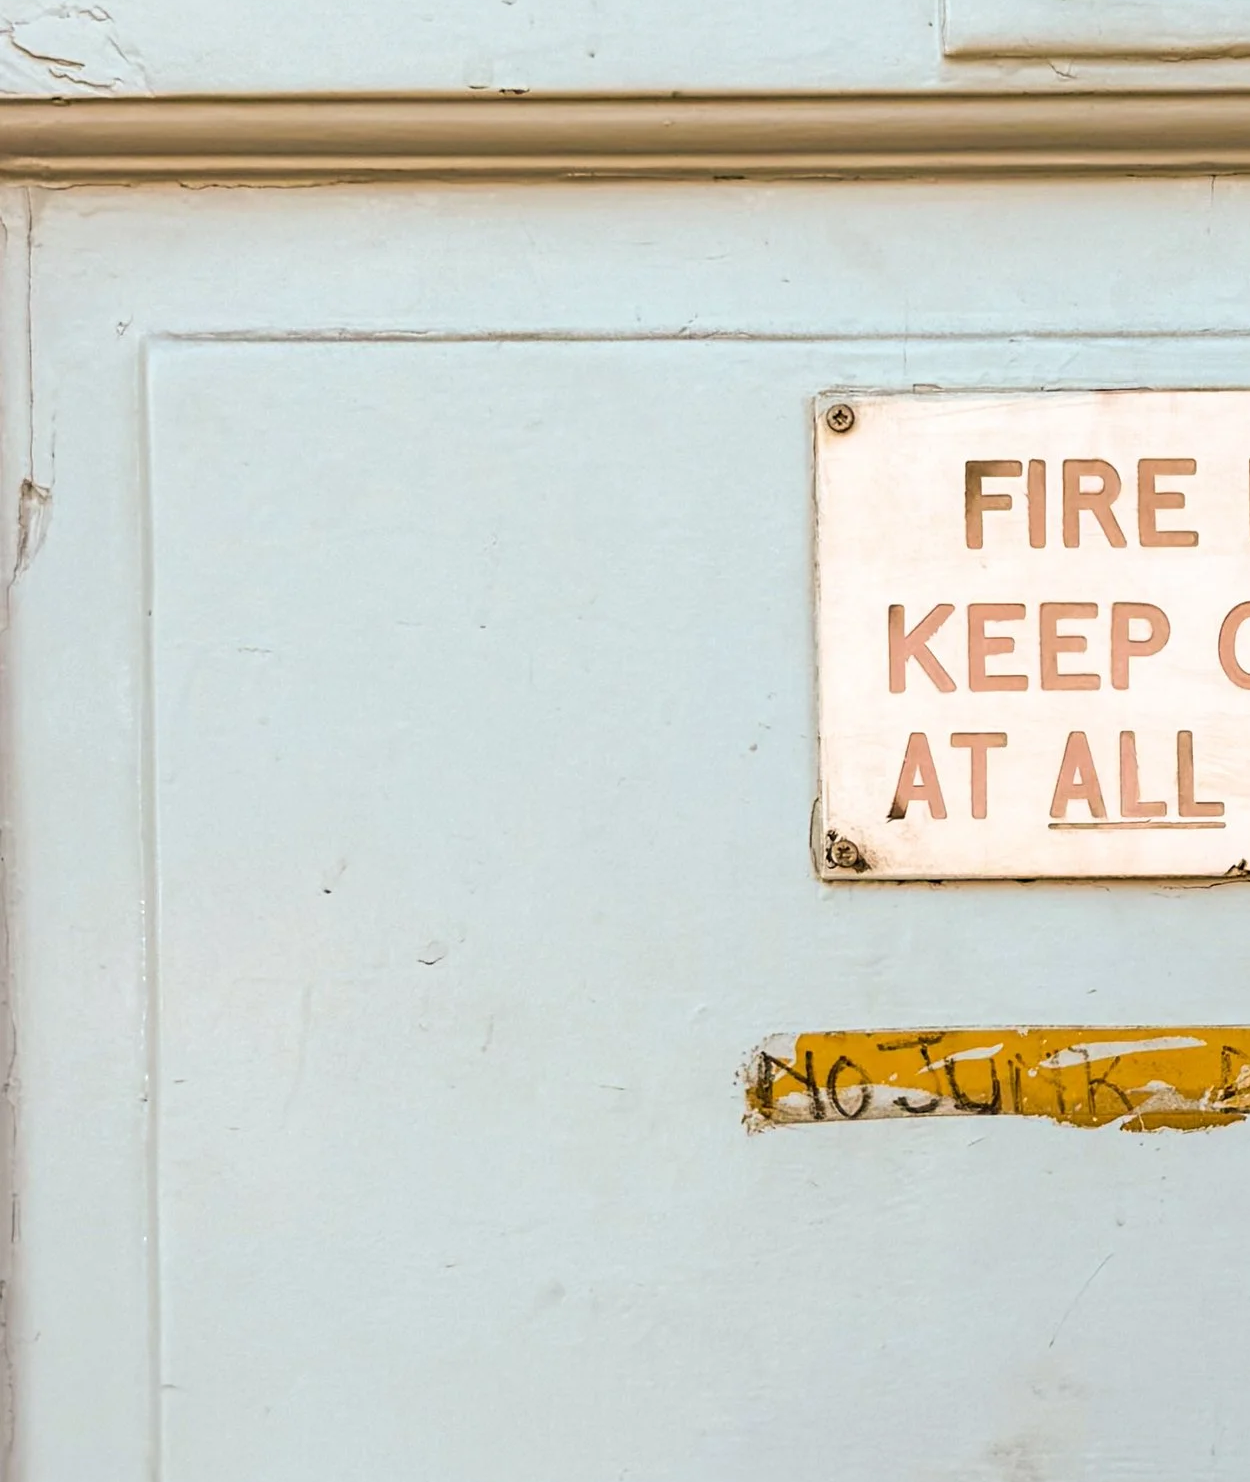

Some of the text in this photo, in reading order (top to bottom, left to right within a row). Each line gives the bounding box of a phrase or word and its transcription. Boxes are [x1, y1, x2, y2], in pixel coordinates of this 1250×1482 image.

[964, 457, 1200, 550] FIRE
[887, 600, 1171, 694] KEEP
[886, 730, 1008, 822] AT
[1048, 729, 1227, 820] ALL
[757, 1049, 873, 1120] NO
